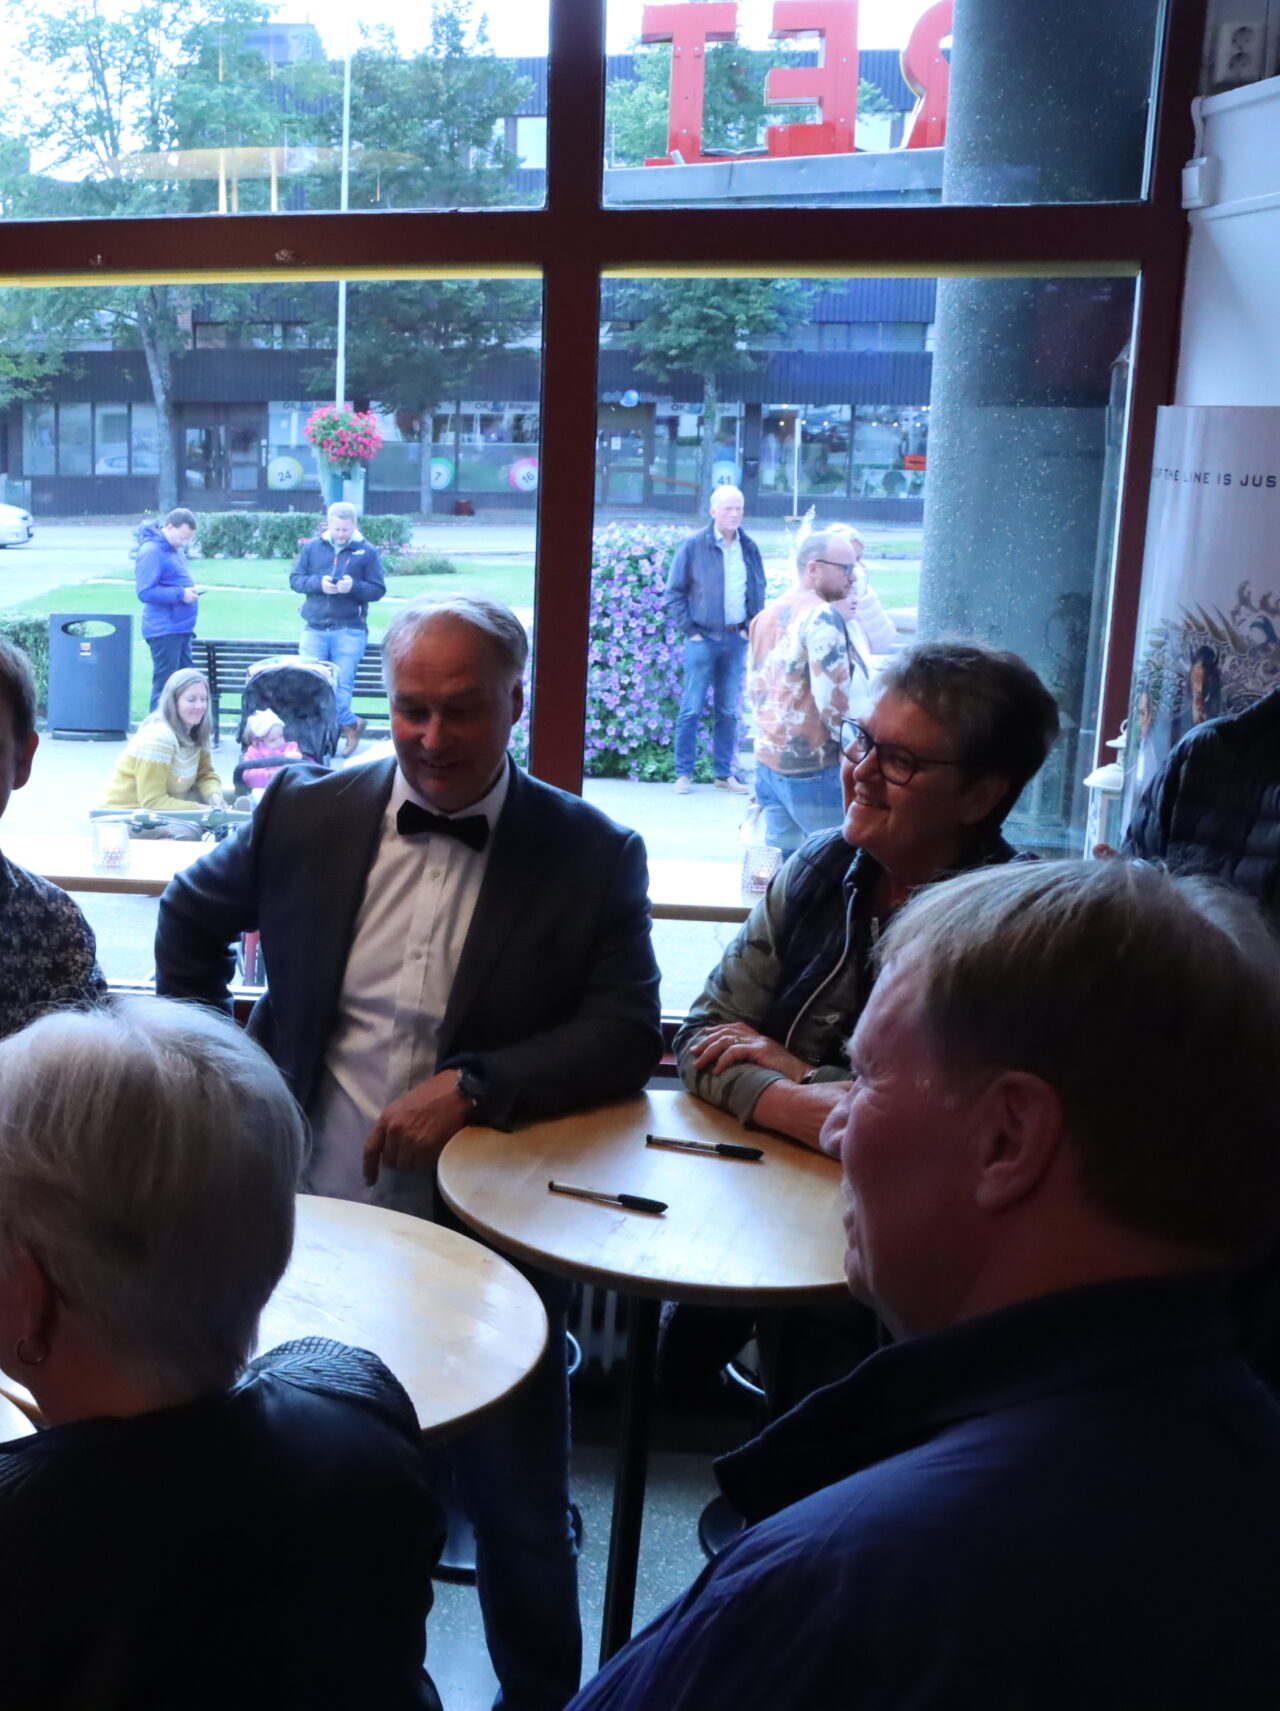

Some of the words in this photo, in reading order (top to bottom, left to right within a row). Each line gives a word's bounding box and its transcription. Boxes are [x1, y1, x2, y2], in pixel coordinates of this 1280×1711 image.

[508, 401, 533, 412] Bingo
[277, 469, 292, 483] 24
[520, 471, 535, 484] 16
[1164, 468, 1180, 482] THE
[1217, 473, 1232, 486] IS
[1240, 474, 1280, 488] JUS
